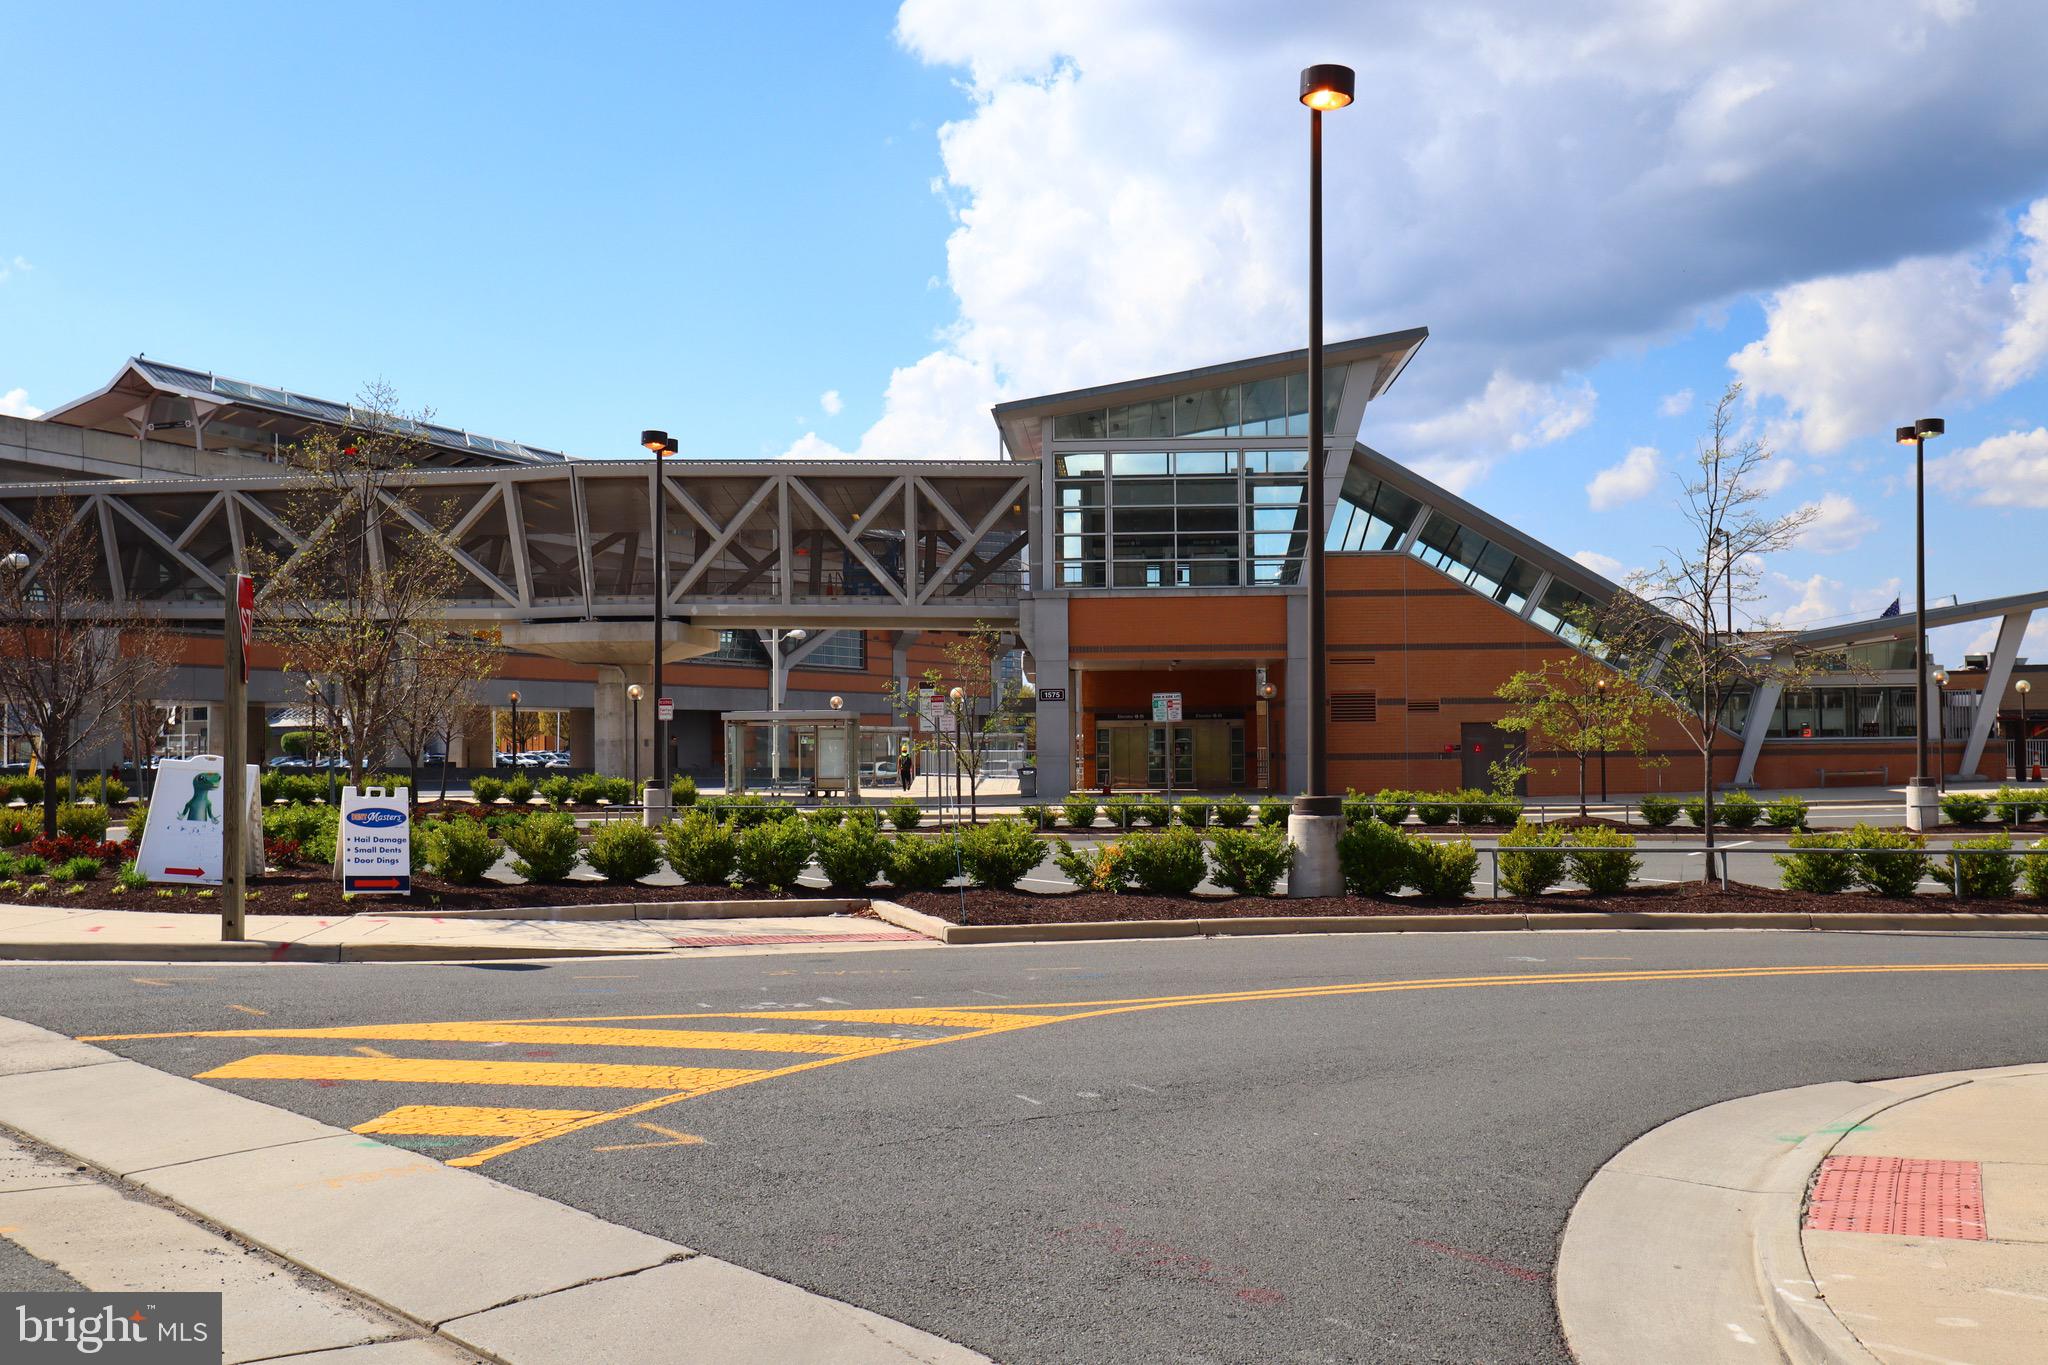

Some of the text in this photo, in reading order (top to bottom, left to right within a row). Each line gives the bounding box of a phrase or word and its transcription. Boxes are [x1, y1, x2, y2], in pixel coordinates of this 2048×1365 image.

[362, 812, 402, 824] Masters
[373, 836, 407, 845] Damage
[354, 846, 402, 854] Small Dents
[376, 857, 400, 865] Dings
